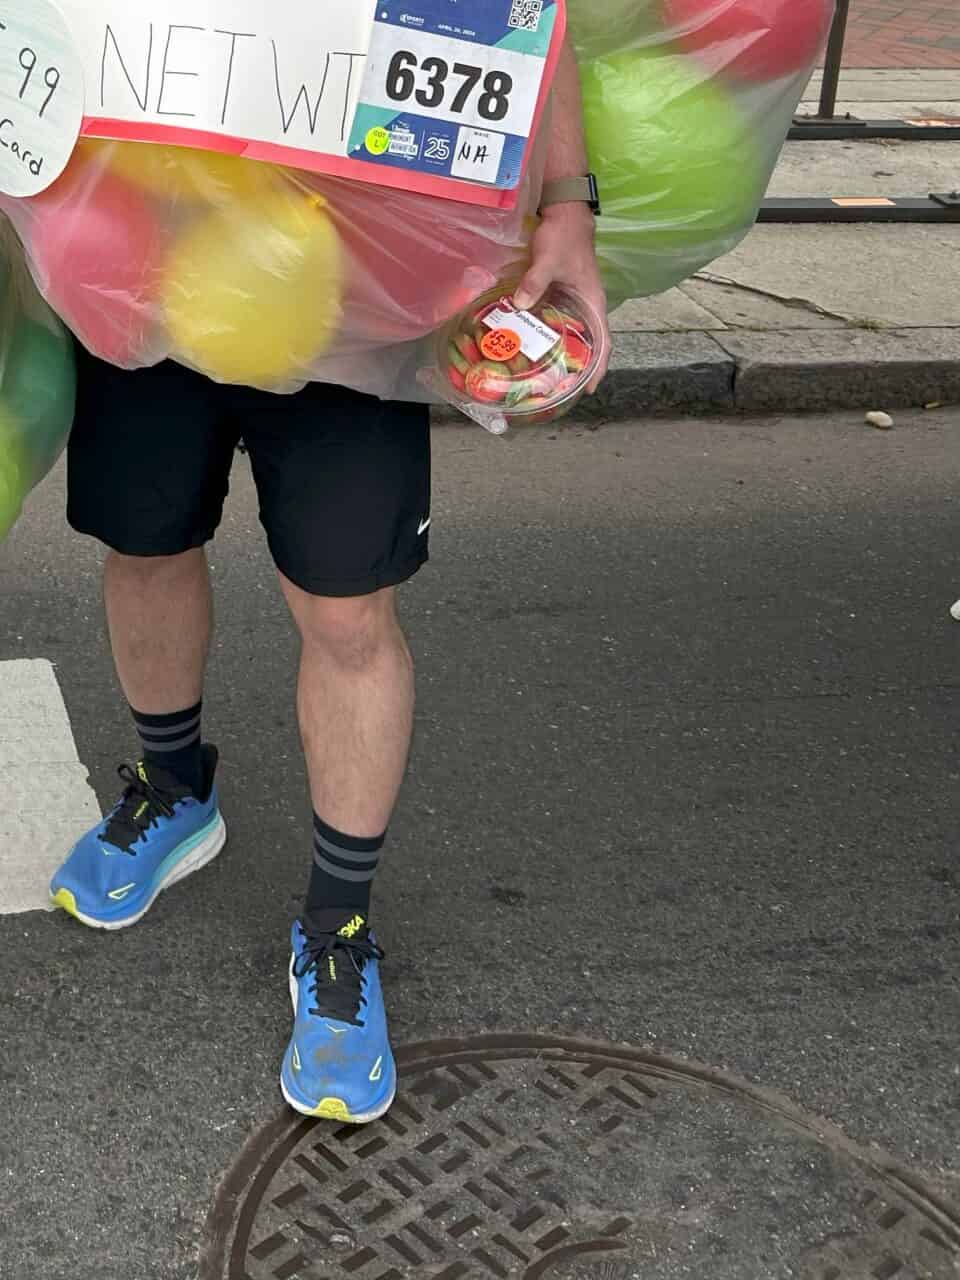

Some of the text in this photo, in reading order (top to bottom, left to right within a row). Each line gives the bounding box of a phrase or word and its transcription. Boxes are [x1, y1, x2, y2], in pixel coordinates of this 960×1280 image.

[100, 22, 257, 126] NET
[384, 49, 514, 122] 6378
[423, 136, 451, 160] 25
